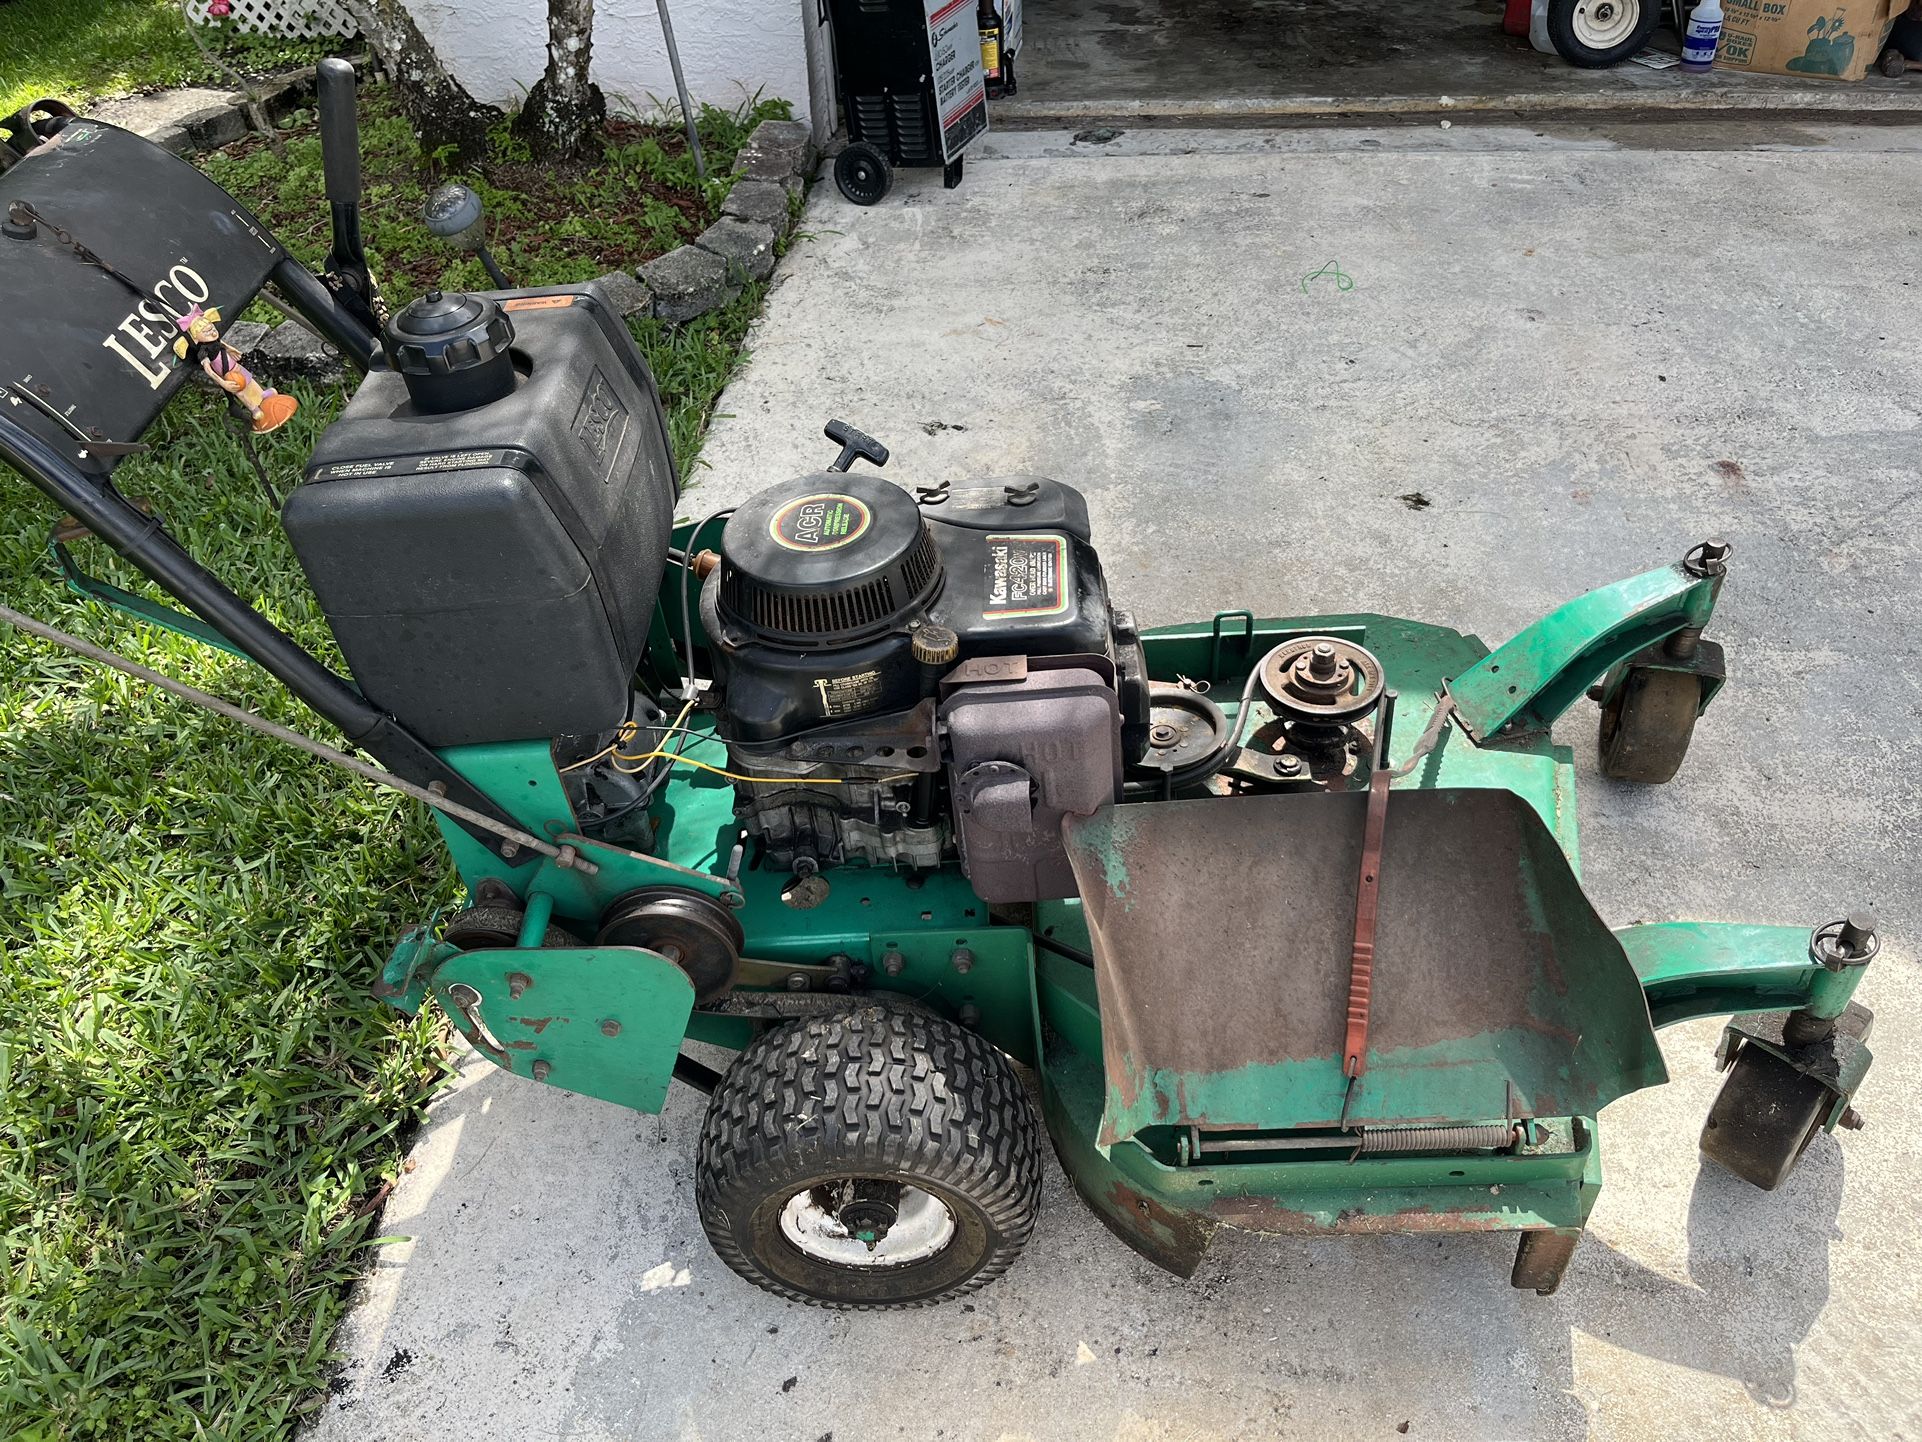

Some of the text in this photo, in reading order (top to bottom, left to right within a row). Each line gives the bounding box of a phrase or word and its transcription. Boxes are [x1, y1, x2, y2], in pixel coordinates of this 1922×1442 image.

[1763, 3, 1786, 15] BOX
[1727, 45, 1749, 58] OK
[102, 265, 209, 390] LESCO
[795, 503, 825, 543] ACR
[823, 509, 833, 536] AUTOMATIC
[831, 503, 844, 536] COMPRESSION
[989, 546, 1008, 604] Kawasaki
[964, 661, 1019, 676] HOT
[1020, 740, 1080, 763] HOT
